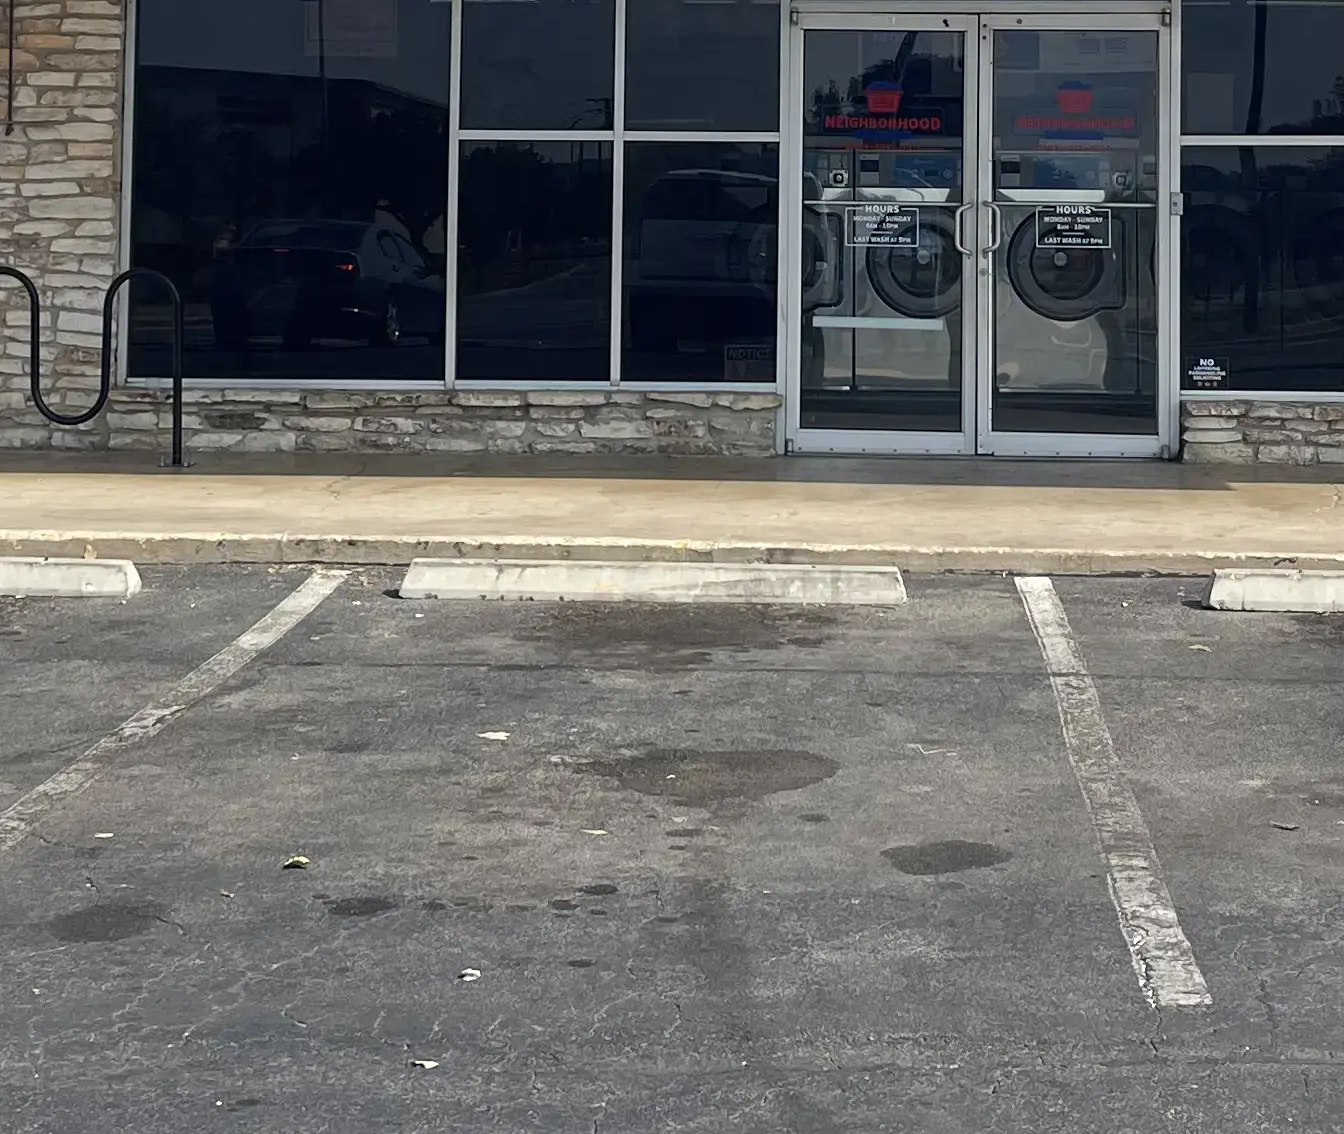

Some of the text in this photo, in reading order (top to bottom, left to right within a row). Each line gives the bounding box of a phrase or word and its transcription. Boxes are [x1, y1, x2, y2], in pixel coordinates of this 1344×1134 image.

[824, 115, 941, 131] NEIGHBORHOOD
[865, 205, 900, 213] HOURS
[1056, 206, 1092, 214] HOURS
[1199, 358, 1215, 366] NO
